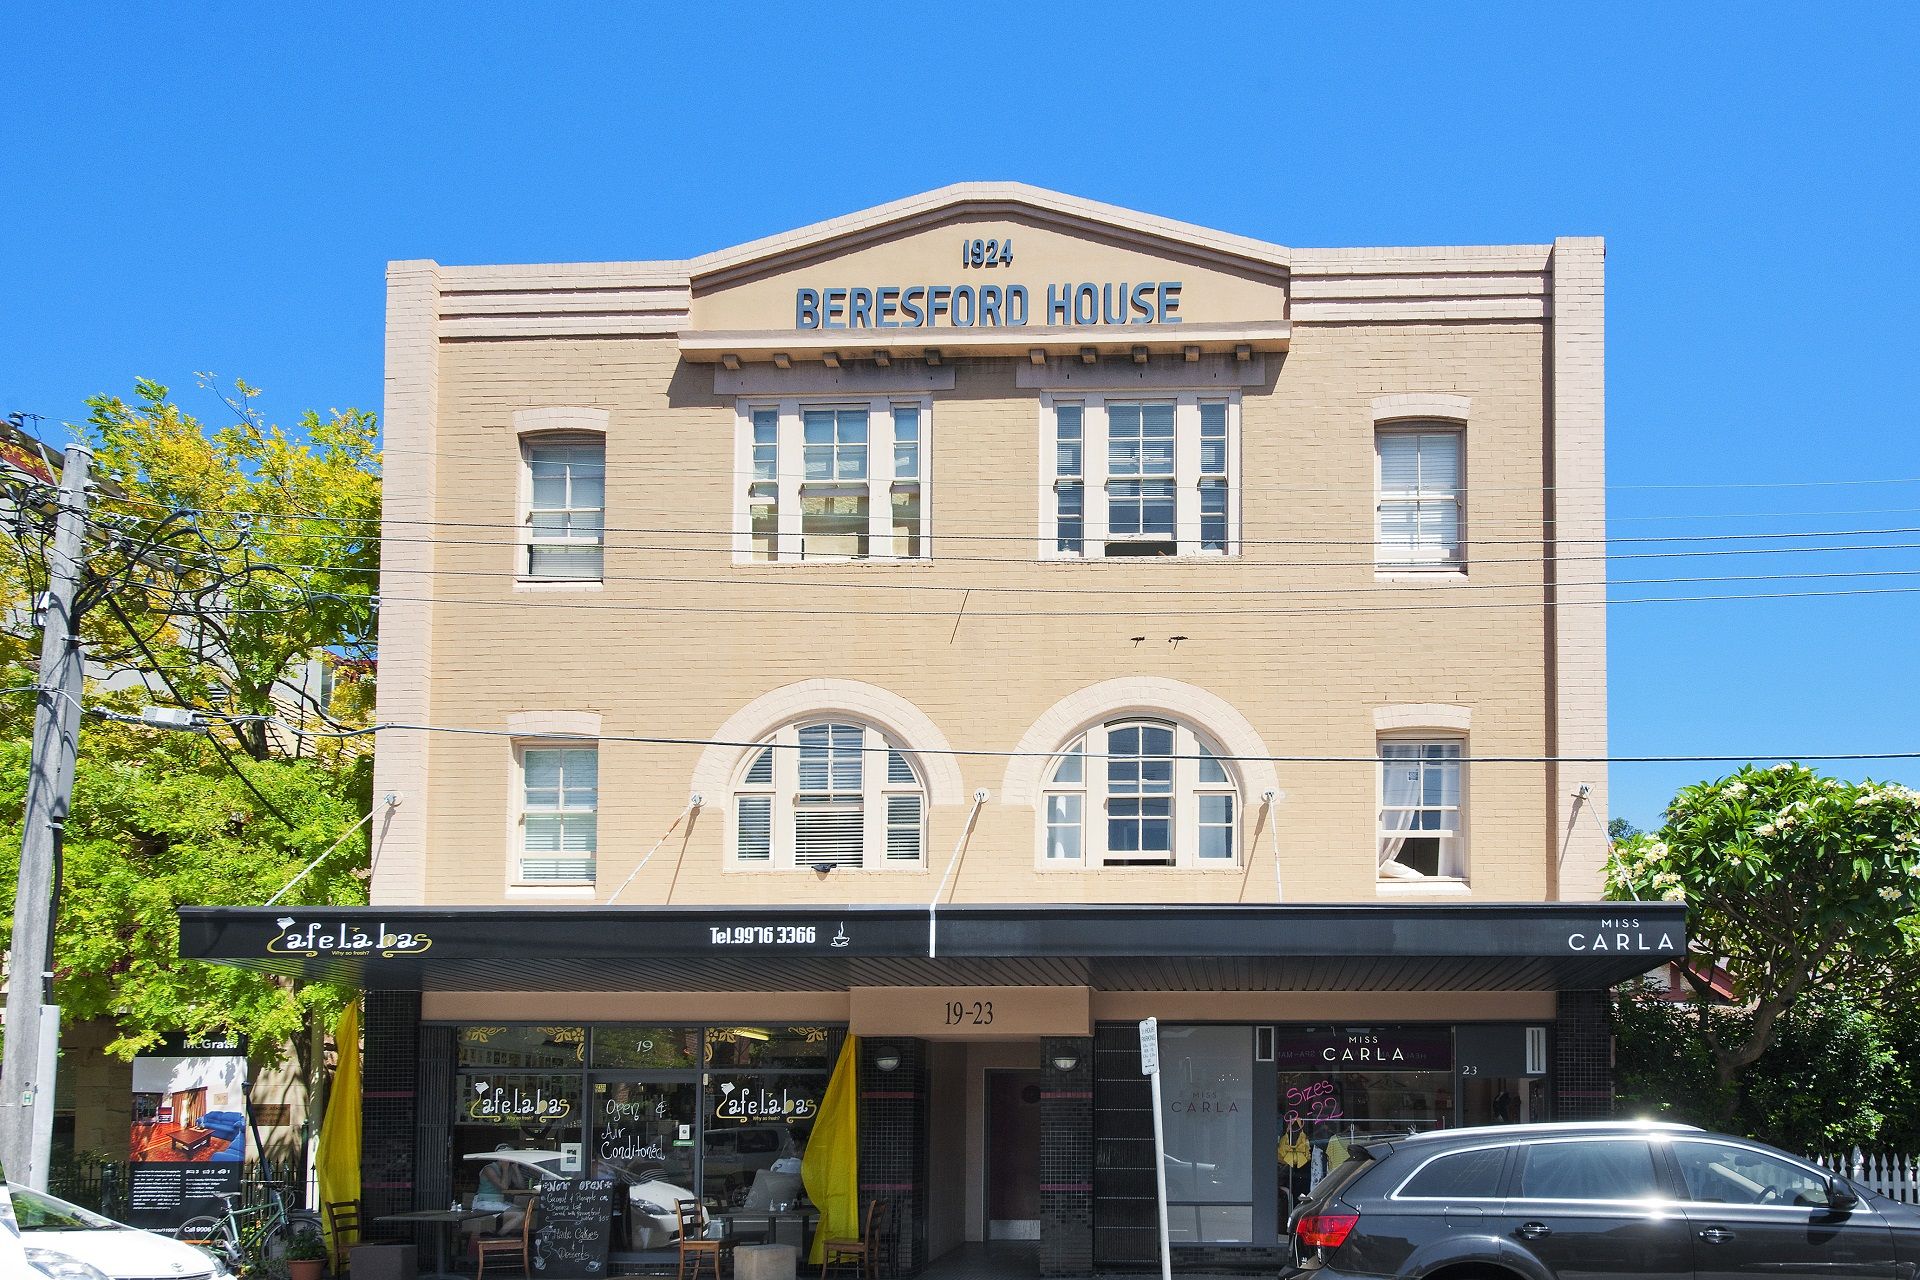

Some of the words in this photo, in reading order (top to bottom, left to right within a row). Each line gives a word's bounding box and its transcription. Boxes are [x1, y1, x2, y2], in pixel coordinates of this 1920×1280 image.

[963, 239, 1013, 267] 1924
[796, 285, 1030, 330] BERESFORD
[1048, 281, 1183, 326] HOUSE
[1601, 918, 1640, 928] MISS
[709, 926, 774, 944] Tel.9976
[776, 926, 816, 944] 3366
[1568, 932, 1674, 951] CARLA
[945, 1001, 994, 1026] 19-23
[636, 1040, 654, 1053] 19
[1348, 1036, 1379, 1044] MISS
[1323, 1047, 1404, 1061] CARLA
[1462, 1065, 1478, 1076] 23
[1286, 1080, 1334, 1106] Sizes
[606, 1099, 640, 1122] Open
[655, 1094, 669, 1119] &
[1171, 1101, 1239, 1113] CARLA
[601, 1122, 626, 1140] Air
[579, 1180, 605, 1191] OPEN
